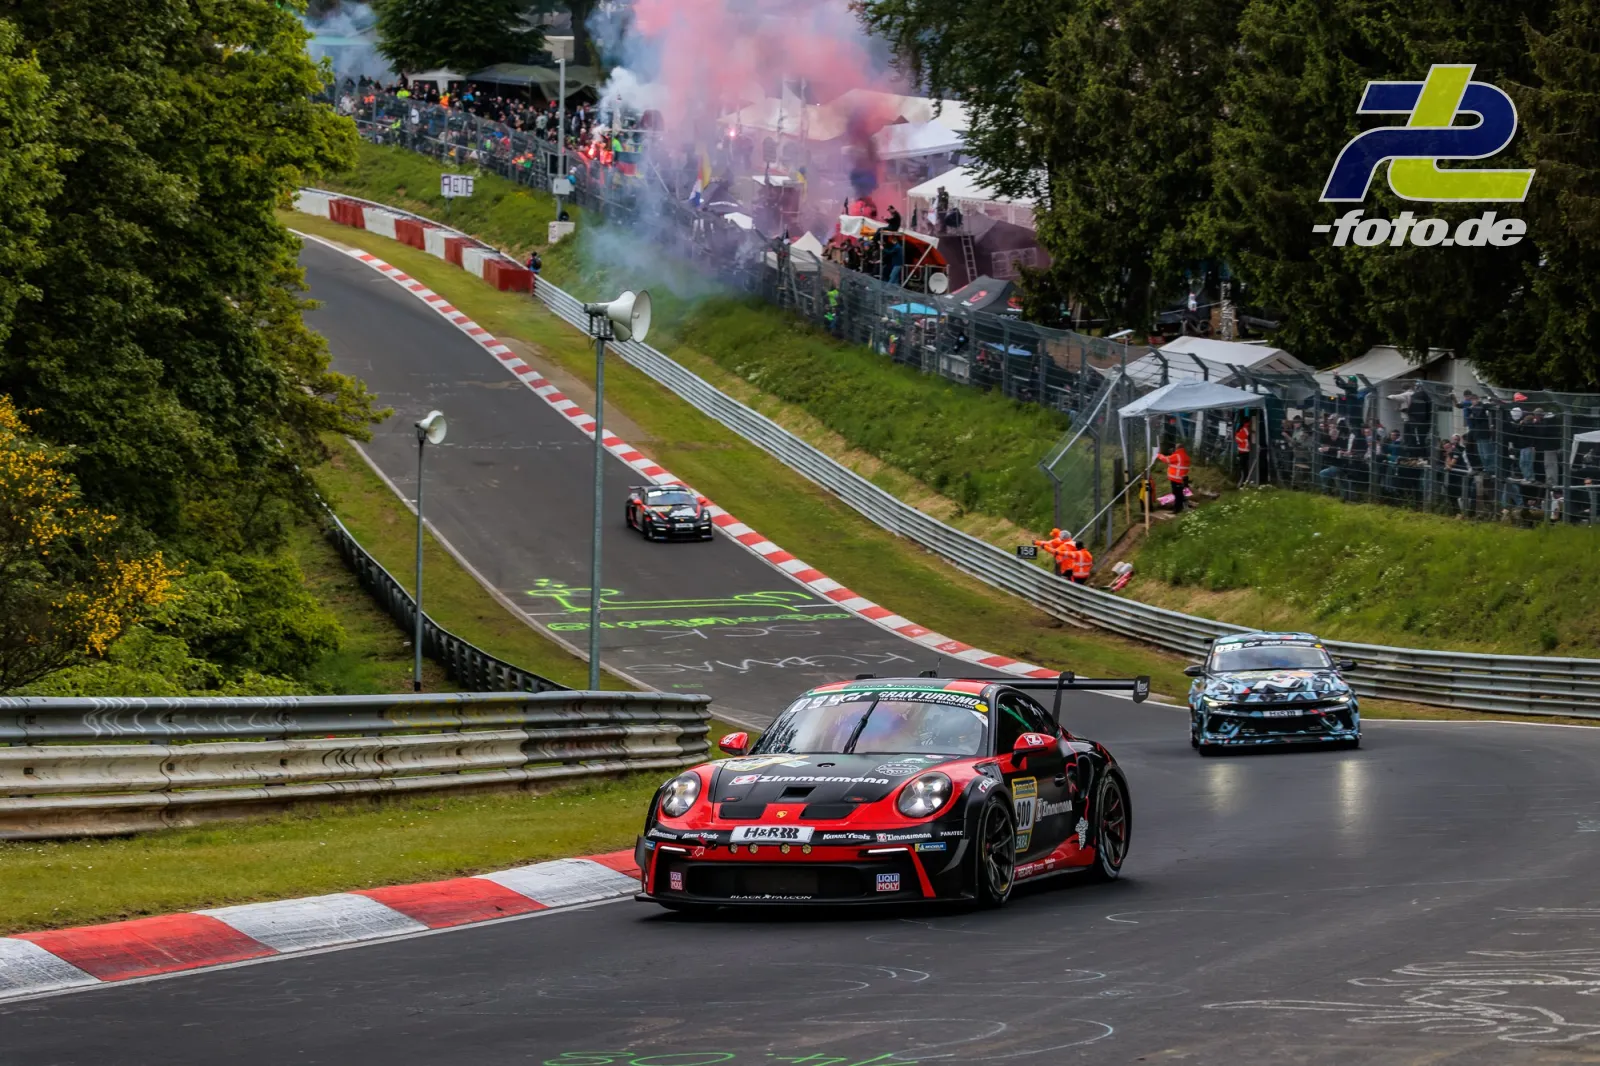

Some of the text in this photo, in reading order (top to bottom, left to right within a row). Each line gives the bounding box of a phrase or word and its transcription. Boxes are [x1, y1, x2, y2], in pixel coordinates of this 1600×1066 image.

[918, 691, 981, 706] TURISMO
[757, 775, 889, 785] Zimmermann
[878, 874, 898, 882] LIQUI
[878, 882, 899, 890] MOLY
